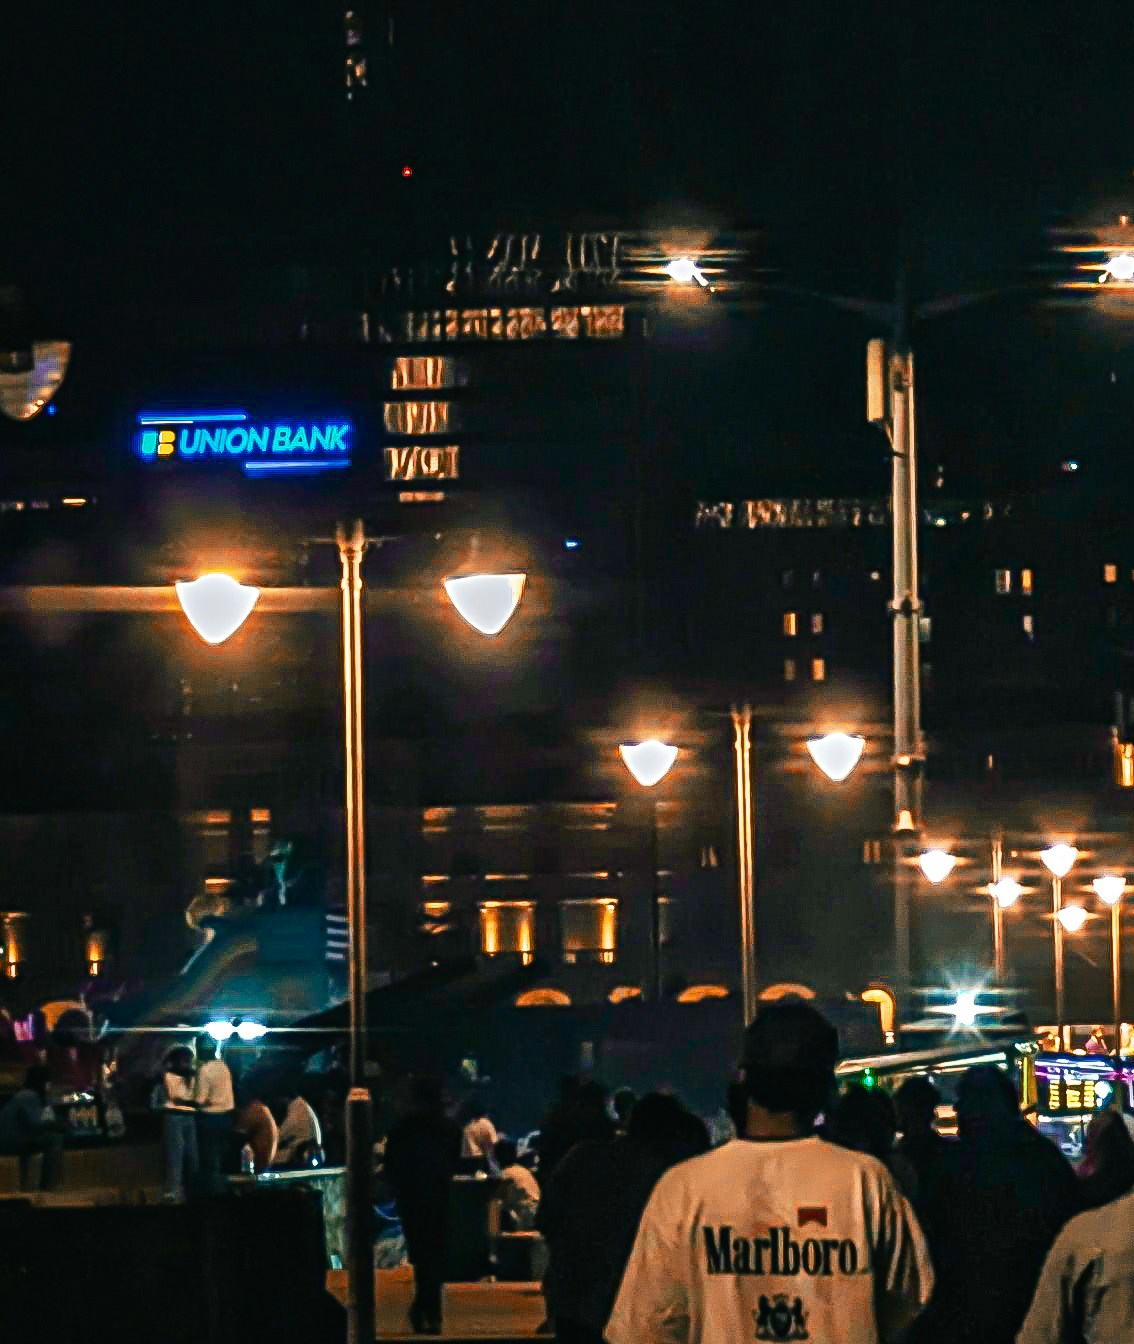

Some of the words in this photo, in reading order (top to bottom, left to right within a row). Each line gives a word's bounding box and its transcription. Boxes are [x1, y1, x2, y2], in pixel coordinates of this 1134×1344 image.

[180, 427, 269, 454] UNION
[271, 425, 349, 452] BANK
[703, 1226, 858, 1275] Marlboro
